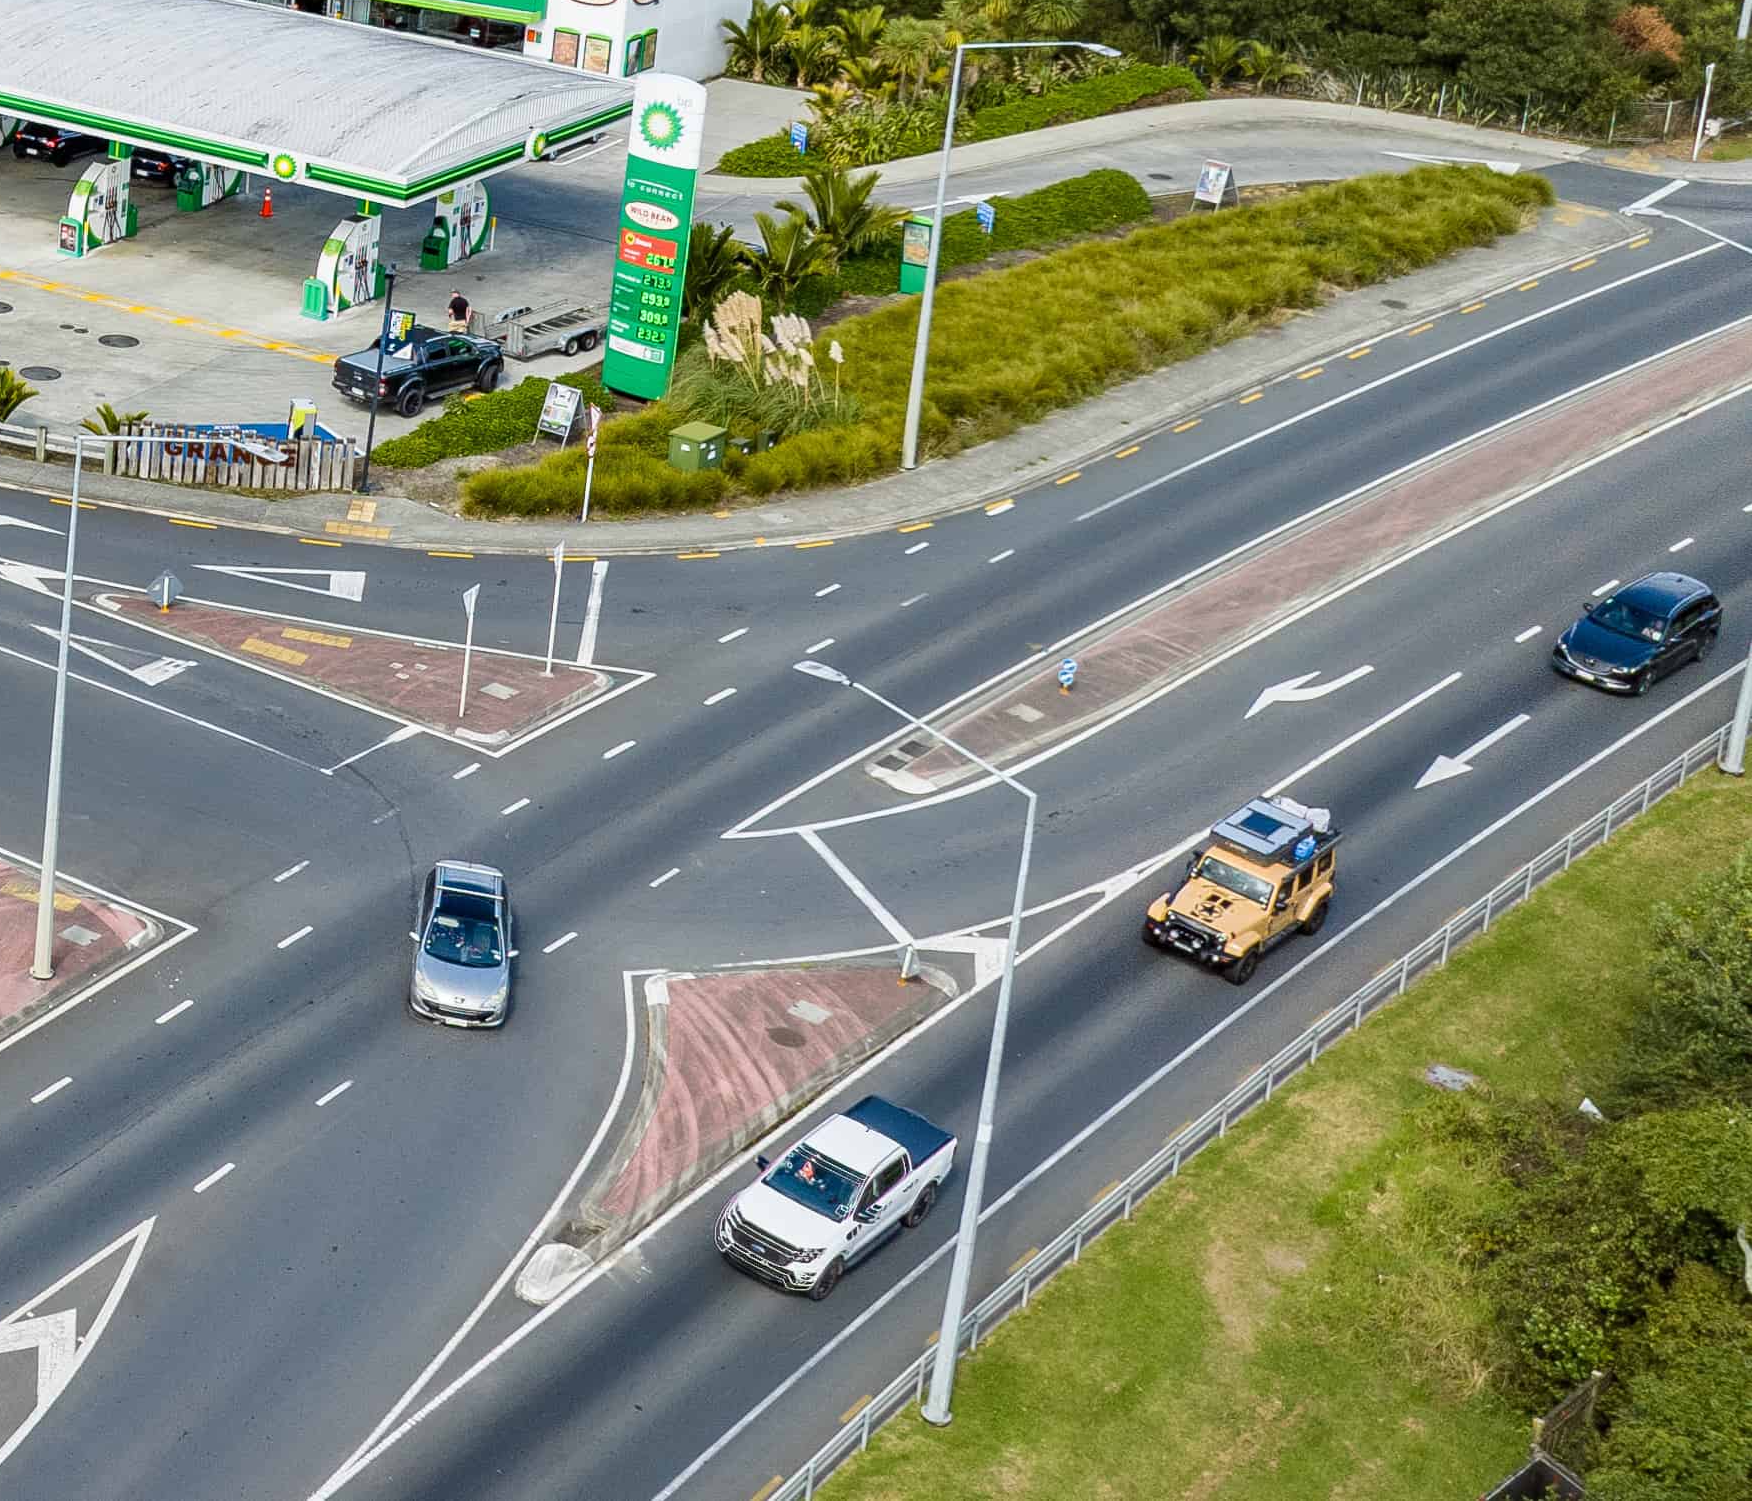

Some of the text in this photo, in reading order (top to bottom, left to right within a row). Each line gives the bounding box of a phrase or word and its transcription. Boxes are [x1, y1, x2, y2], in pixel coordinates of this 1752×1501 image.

[630, 206, 673, 223] WILD BEAN
[164, 441, 297, 468] GRANE
